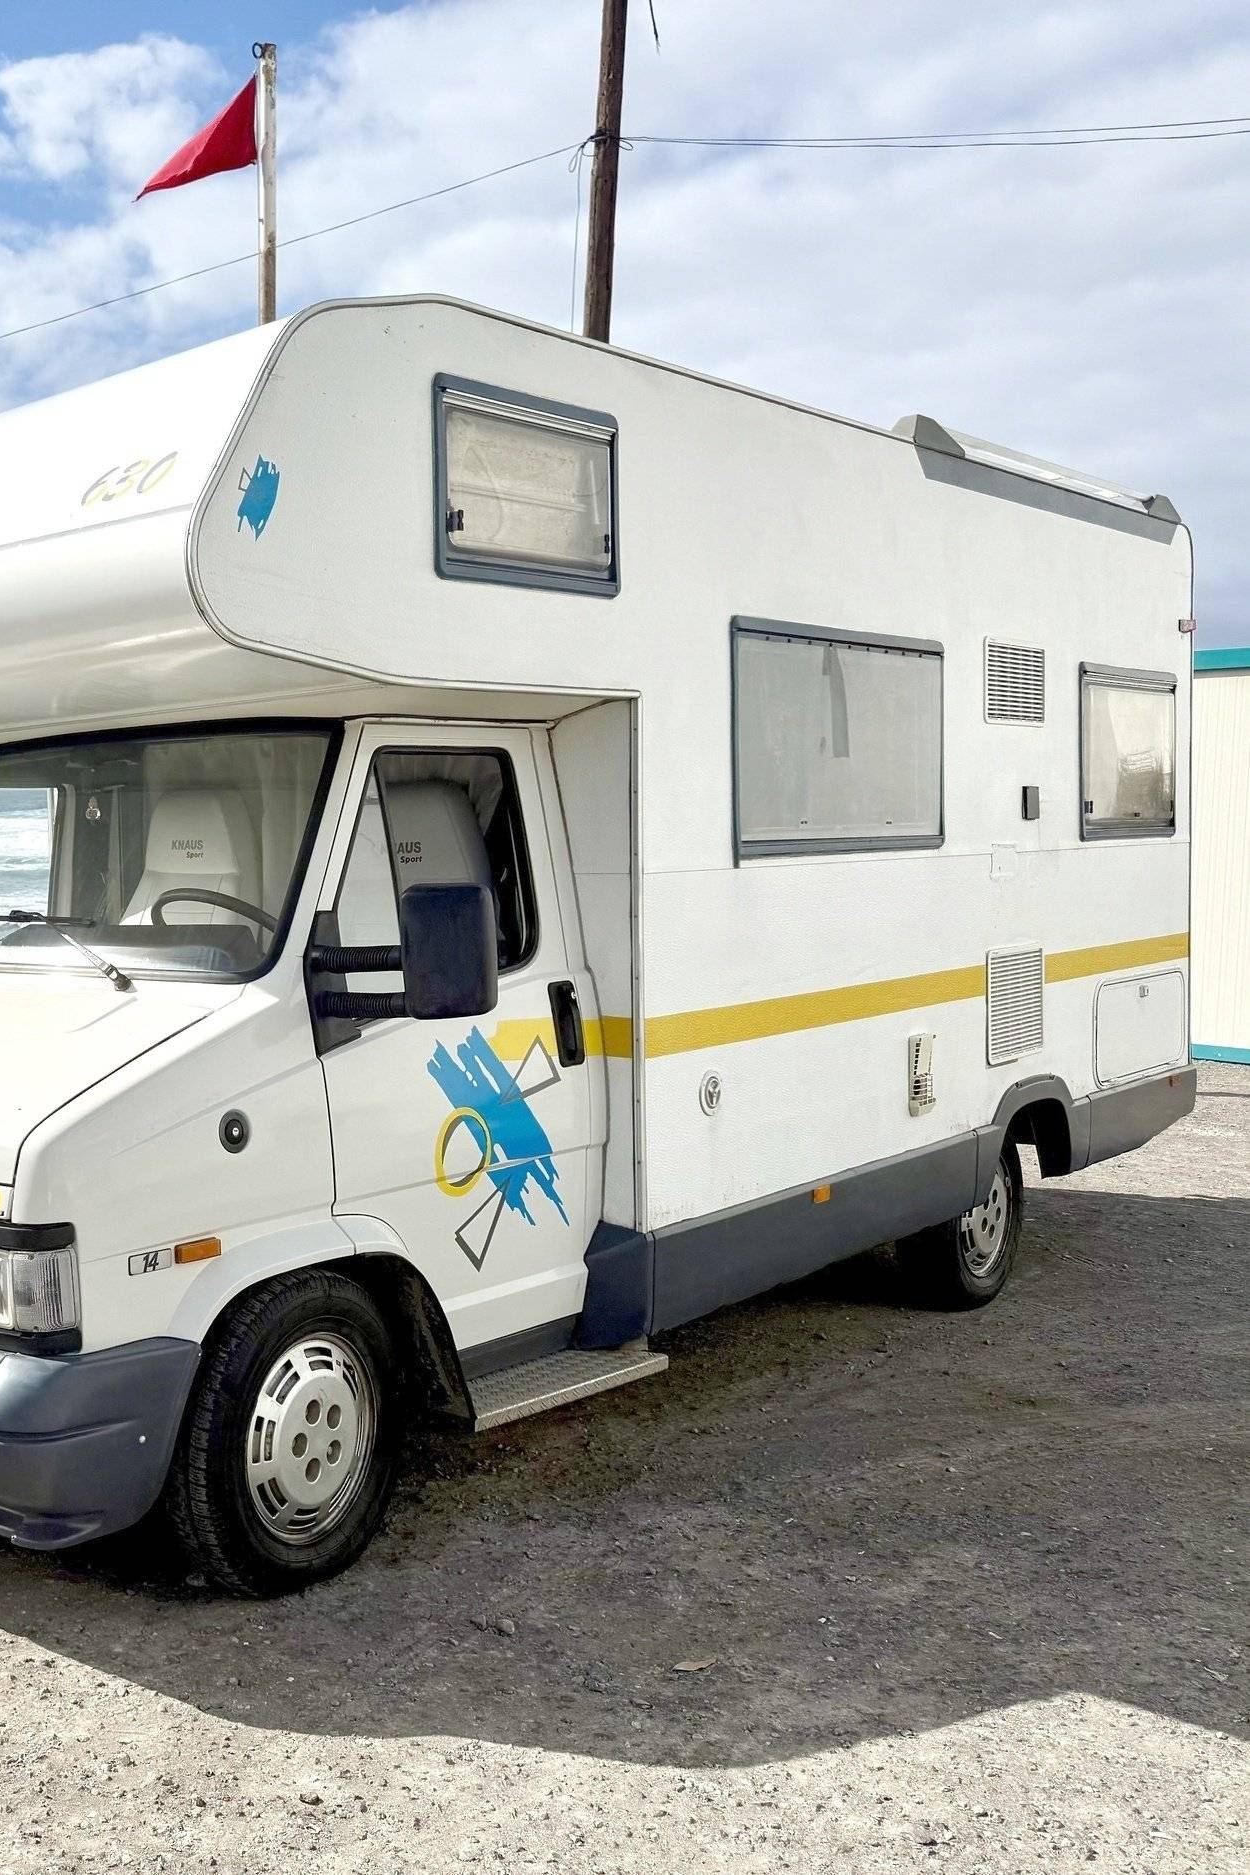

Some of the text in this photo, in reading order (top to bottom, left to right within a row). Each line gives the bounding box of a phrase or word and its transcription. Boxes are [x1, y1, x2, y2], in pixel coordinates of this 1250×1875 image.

[171, 839, 204, 851] KNAUS
[395, 841, 422, 854] AUS
[186, 851, 204, 860] Sport
[399, 855, 423, 864] Sport
[142, 1251, 160, 1273] 14
